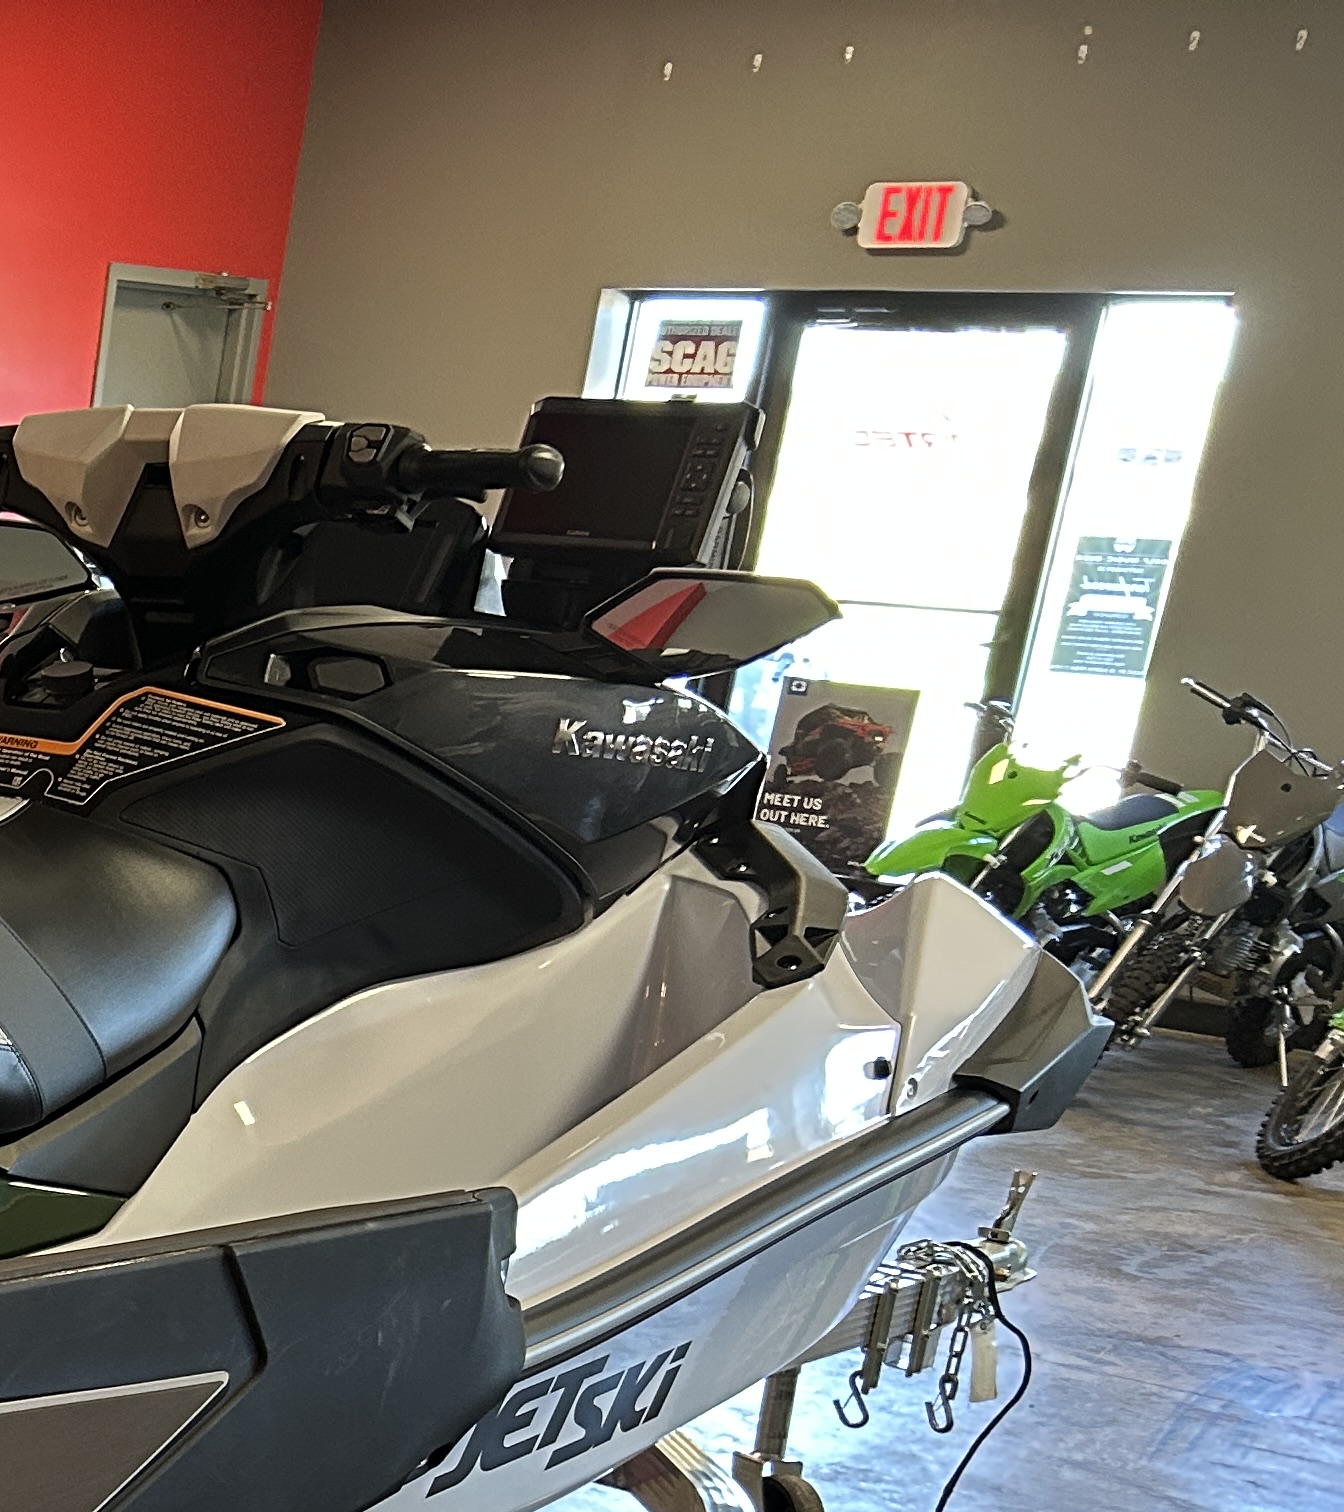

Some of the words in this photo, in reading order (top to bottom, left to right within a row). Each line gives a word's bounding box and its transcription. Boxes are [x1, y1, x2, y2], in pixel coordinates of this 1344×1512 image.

[874, 186, 955, 243] EXIT
[650, 341, 737, 373] SCAG
[551, 718, 715, 773] Kawasaki
[763, 793, 801, 808] MEET
[803, 797, 823, 810] US
[760, 808, 787, 822] OUT
[790, 812, 830, 828] HERE.
